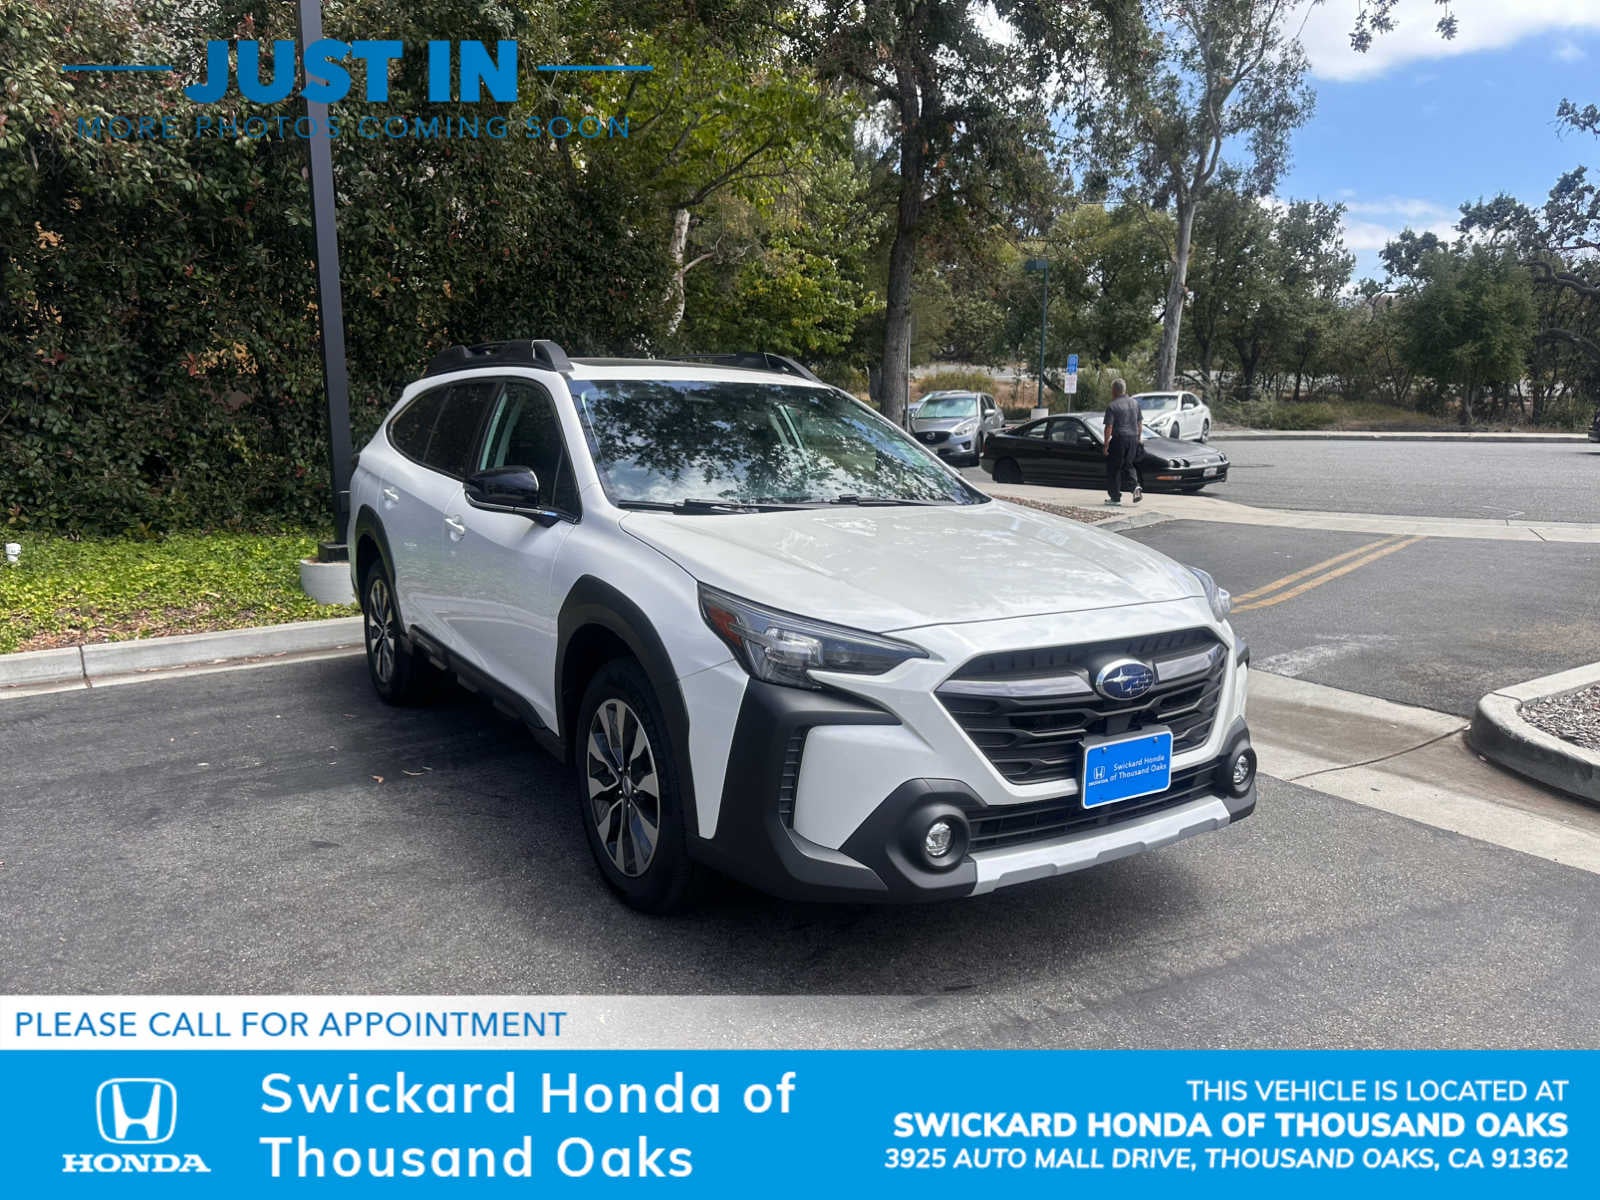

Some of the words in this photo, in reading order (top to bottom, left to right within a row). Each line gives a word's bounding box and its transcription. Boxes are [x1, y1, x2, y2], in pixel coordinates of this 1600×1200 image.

[1113, 758, 1143, 771] Swickard
[1144, 754, 1165, 765] Honda
[1109, 774, 1117, 782] of
[1119, 767, 1150, 779] Thousand
[1151, 763, 1167, 773] Oaks
